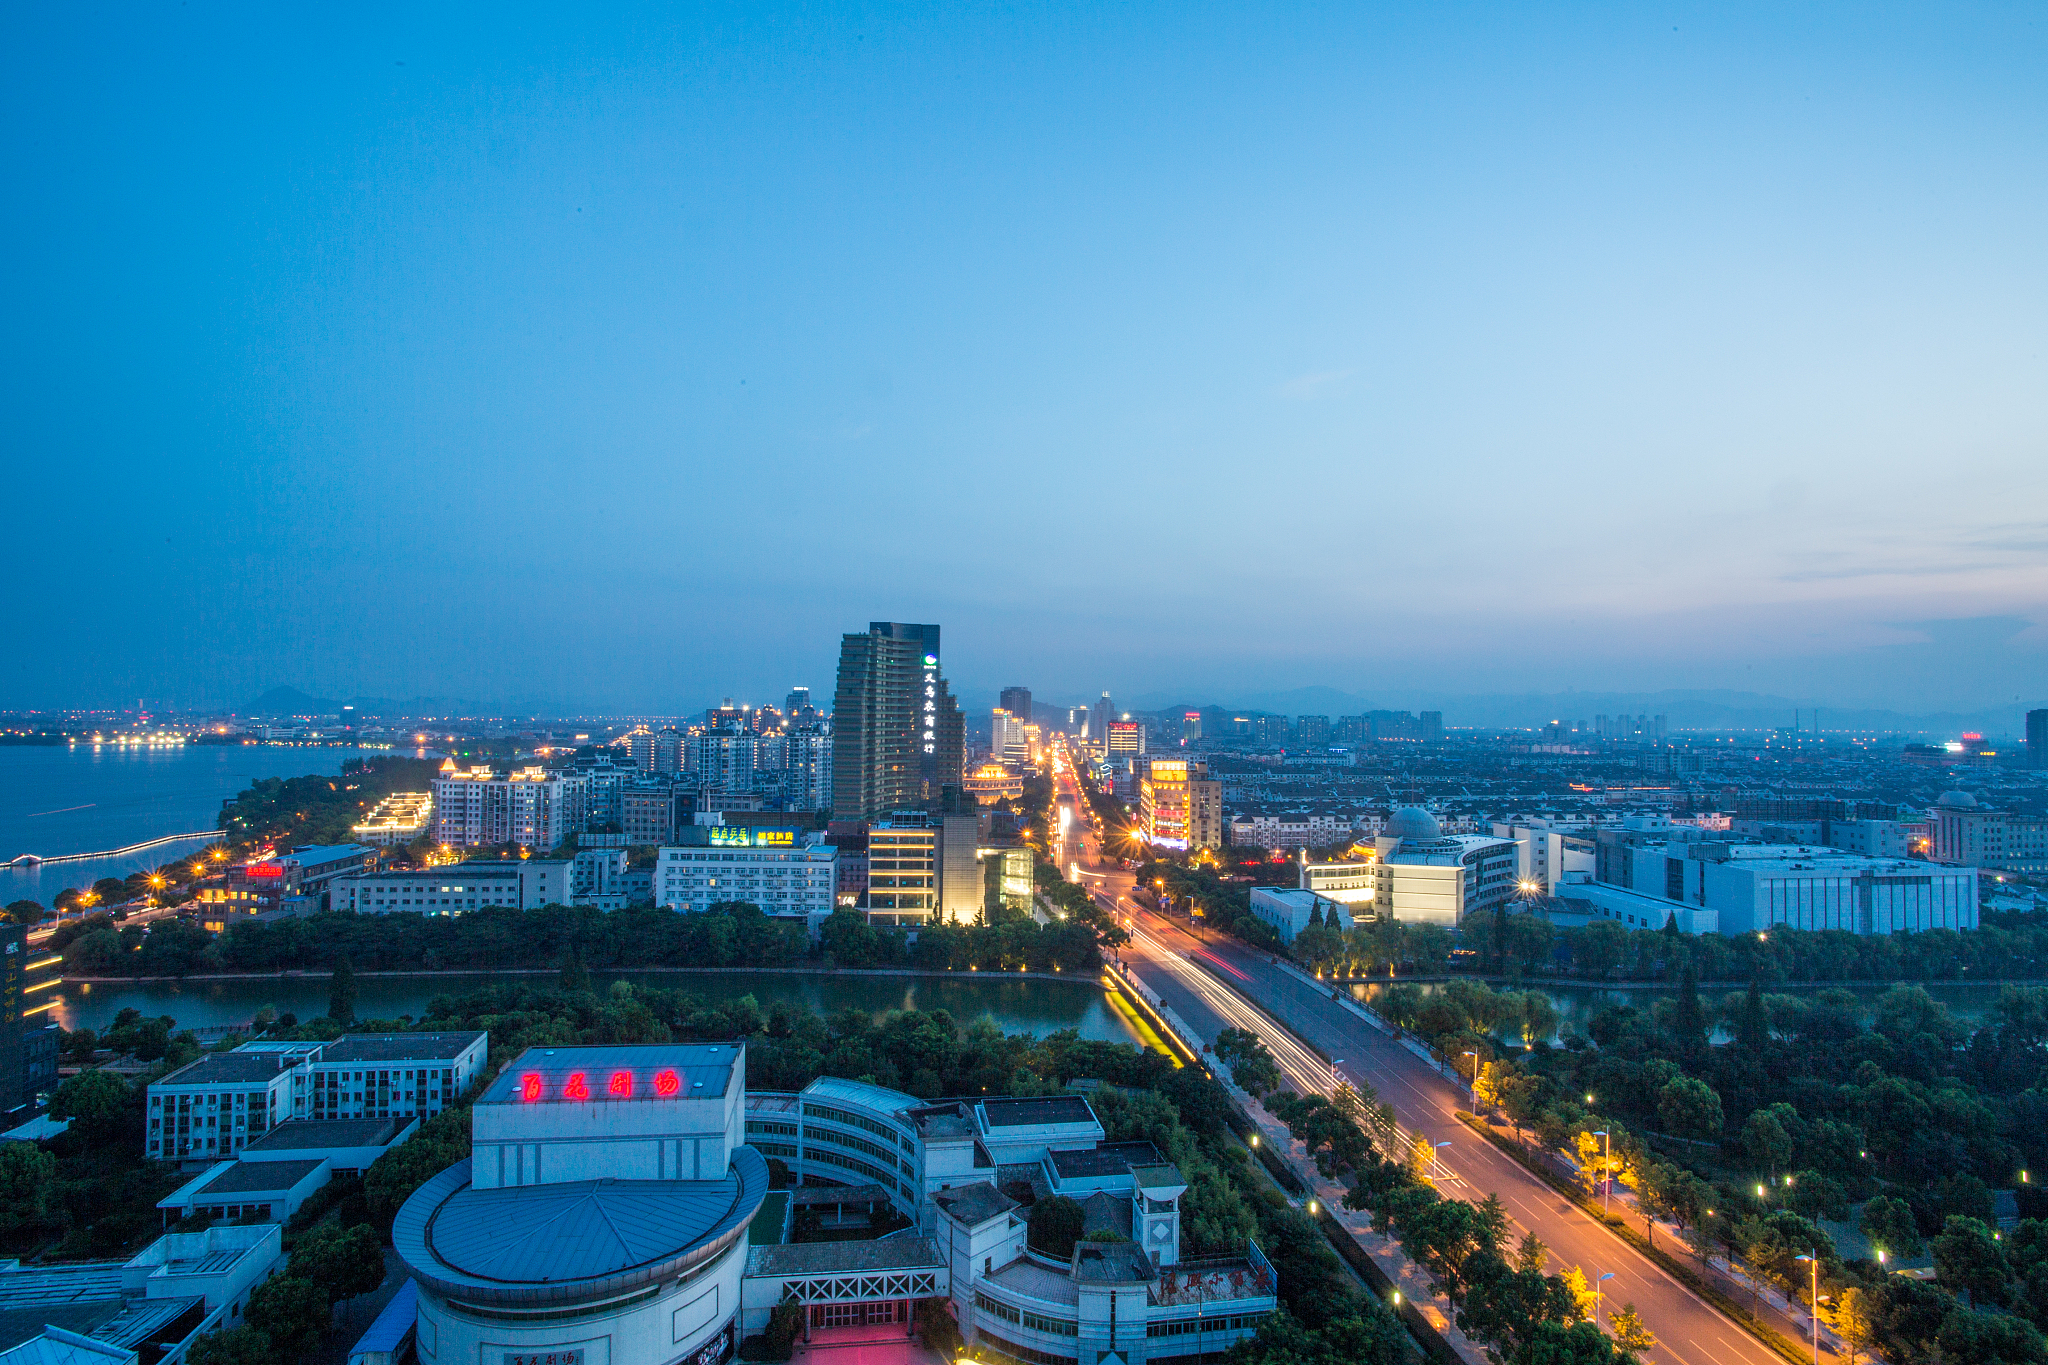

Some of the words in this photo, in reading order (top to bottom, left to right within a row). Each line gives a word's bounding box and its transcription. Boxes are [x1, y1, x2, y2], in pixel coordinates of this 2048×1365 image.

[923, 672, 937, 754] 义乌农商银行
[711, 826, 747, 840] 起点乒乓
[522, 1070, 680, 1100] 百花剧场
